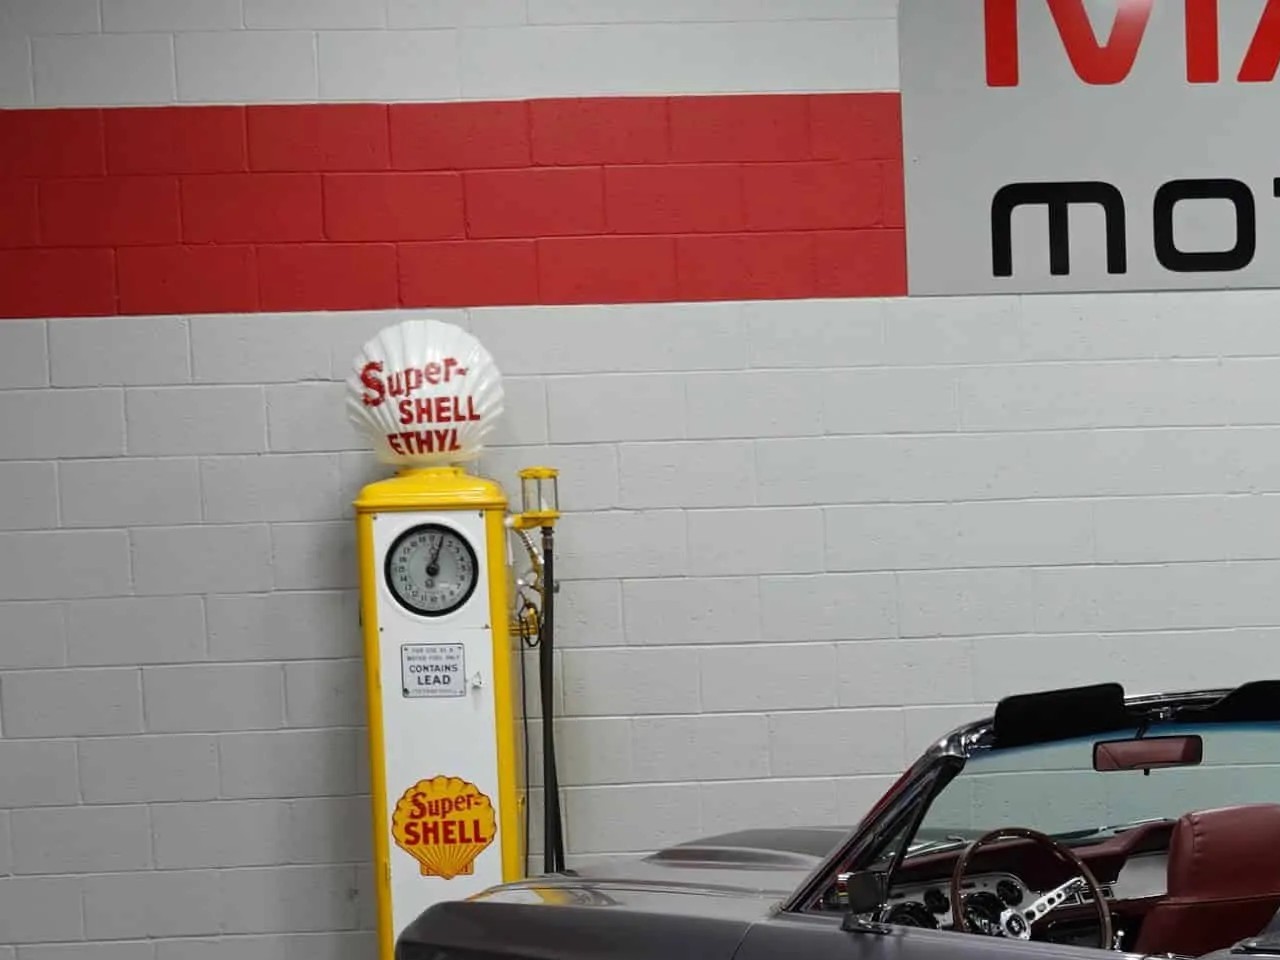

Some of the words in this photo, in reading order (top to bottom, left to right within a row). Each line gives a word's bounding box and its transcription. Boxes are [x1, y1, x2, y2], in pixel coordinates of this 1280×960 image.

[399, 395, 481, 425] SHELL
[386, 427, 462, 456] ETHYL
[408, 664, 458, 674] CONTAINS
[417, 674, 451, 686] LEAD
[403, 819, 487, 846] SHELL
